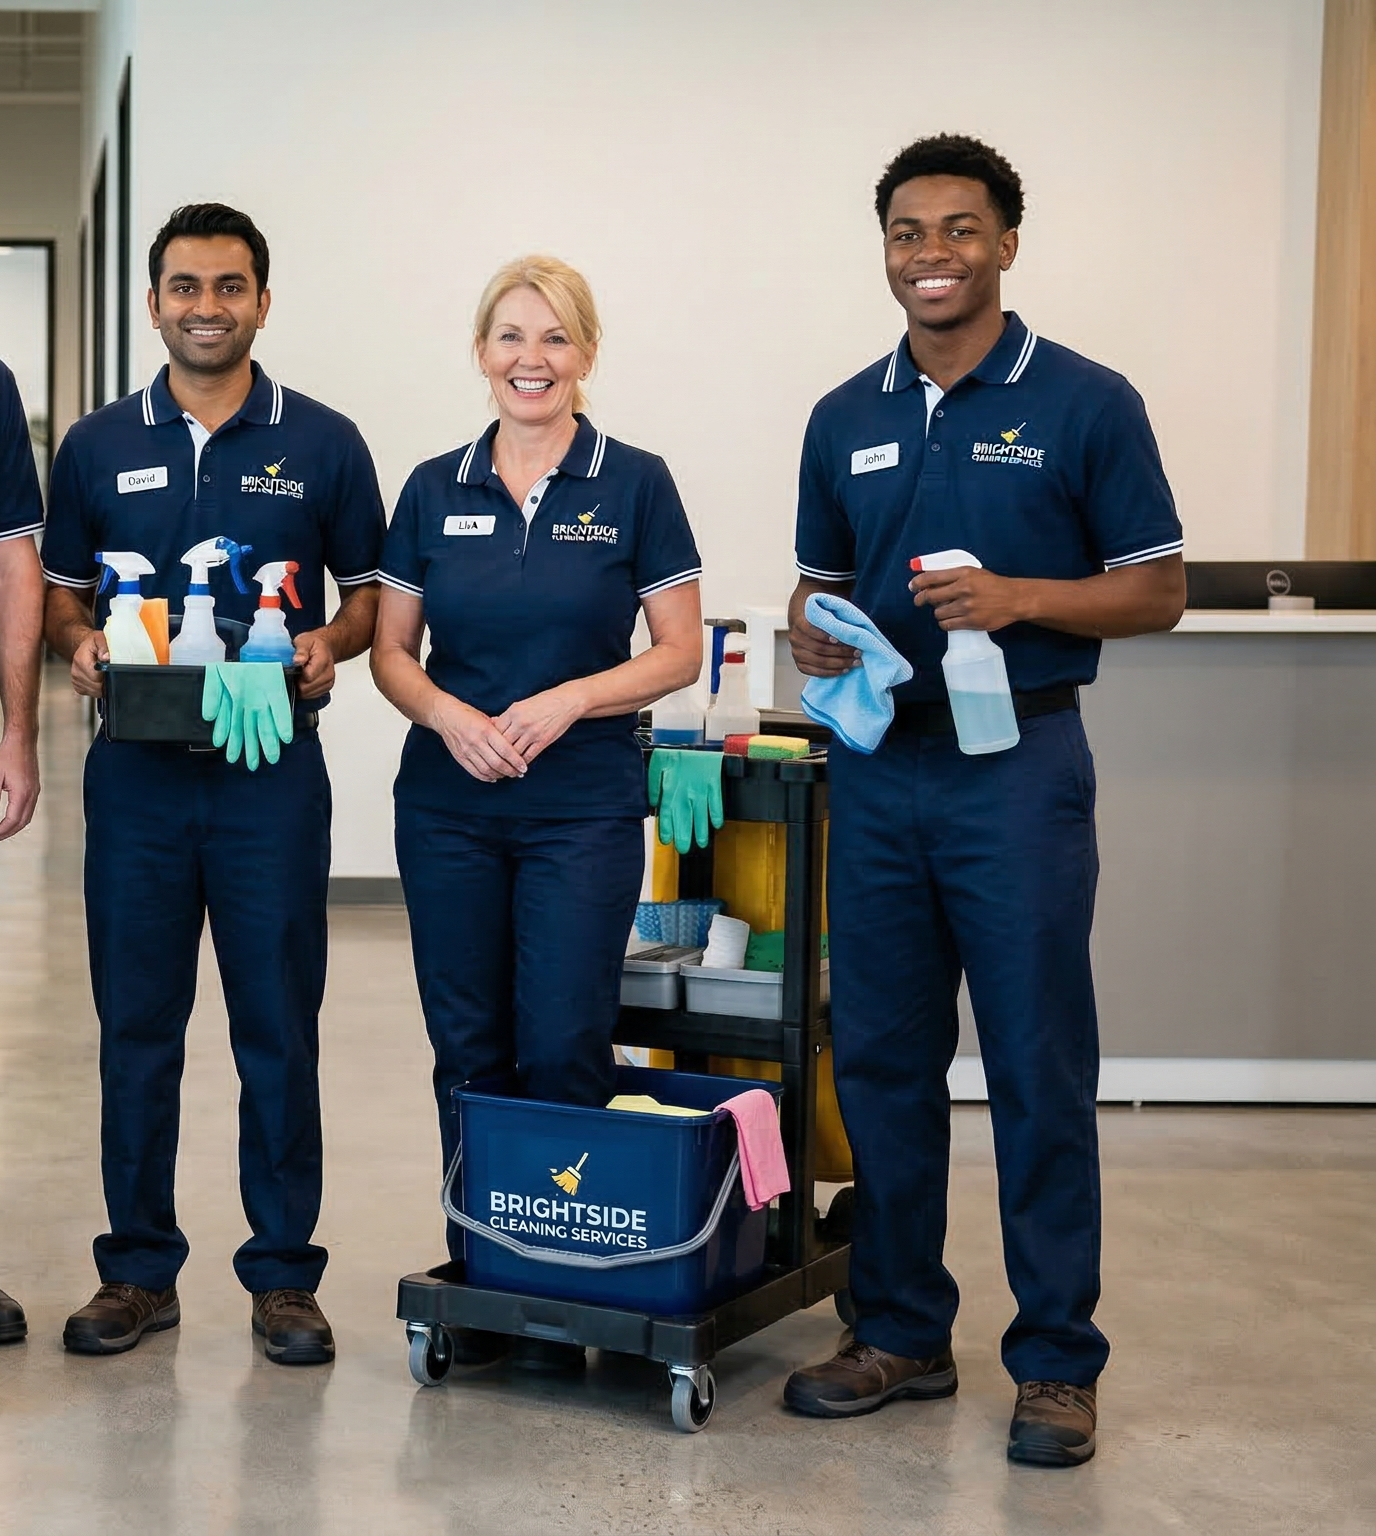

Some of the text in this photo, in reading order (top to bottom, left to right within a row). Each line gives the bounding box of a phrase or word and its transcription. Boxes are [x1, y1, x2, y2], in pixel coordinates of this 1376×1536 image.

[128, 473, 156, 486] David
[490, 1191, 647, 1231] BRIGHTSIDE
[489, 1215, 648, 1249] CLEANING SERVICES
